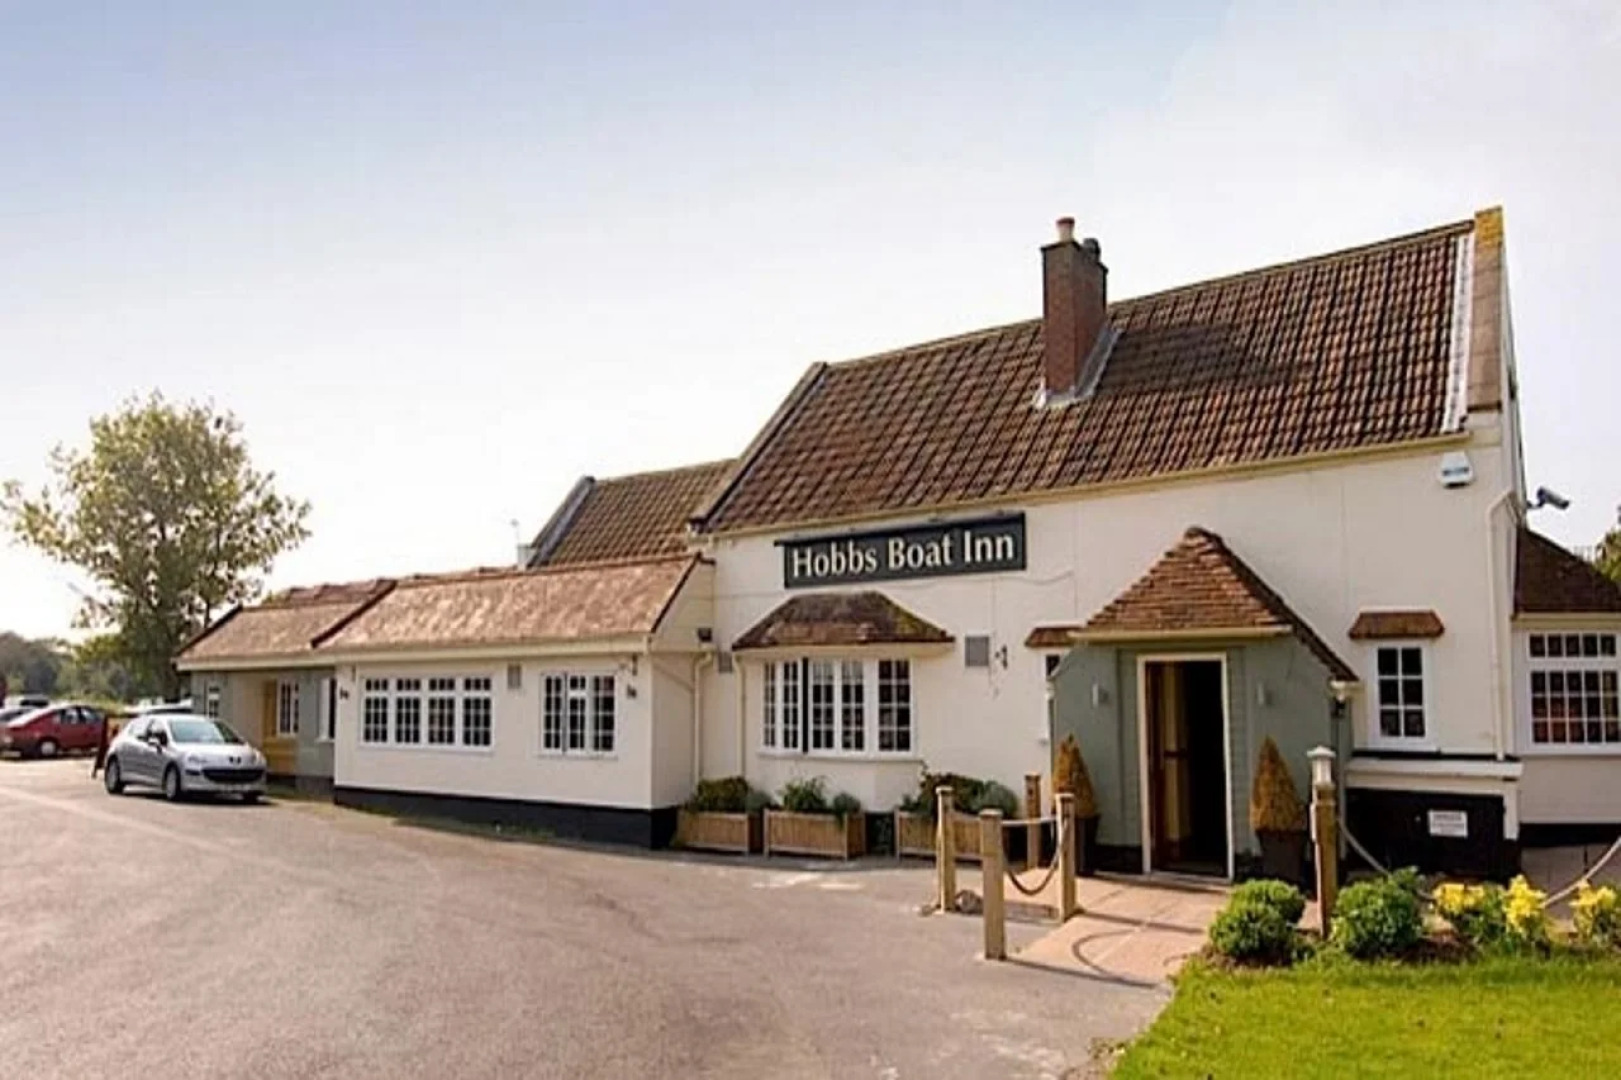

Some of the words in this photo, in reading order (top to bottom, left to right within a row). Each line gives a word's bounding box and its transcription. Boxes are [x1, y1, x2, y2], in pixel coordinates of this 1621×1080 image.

[792, 539, 878, 577] Hobbs
[888, 533, 952, 570] Boat
[964, 530, 1014, 563] Inn
